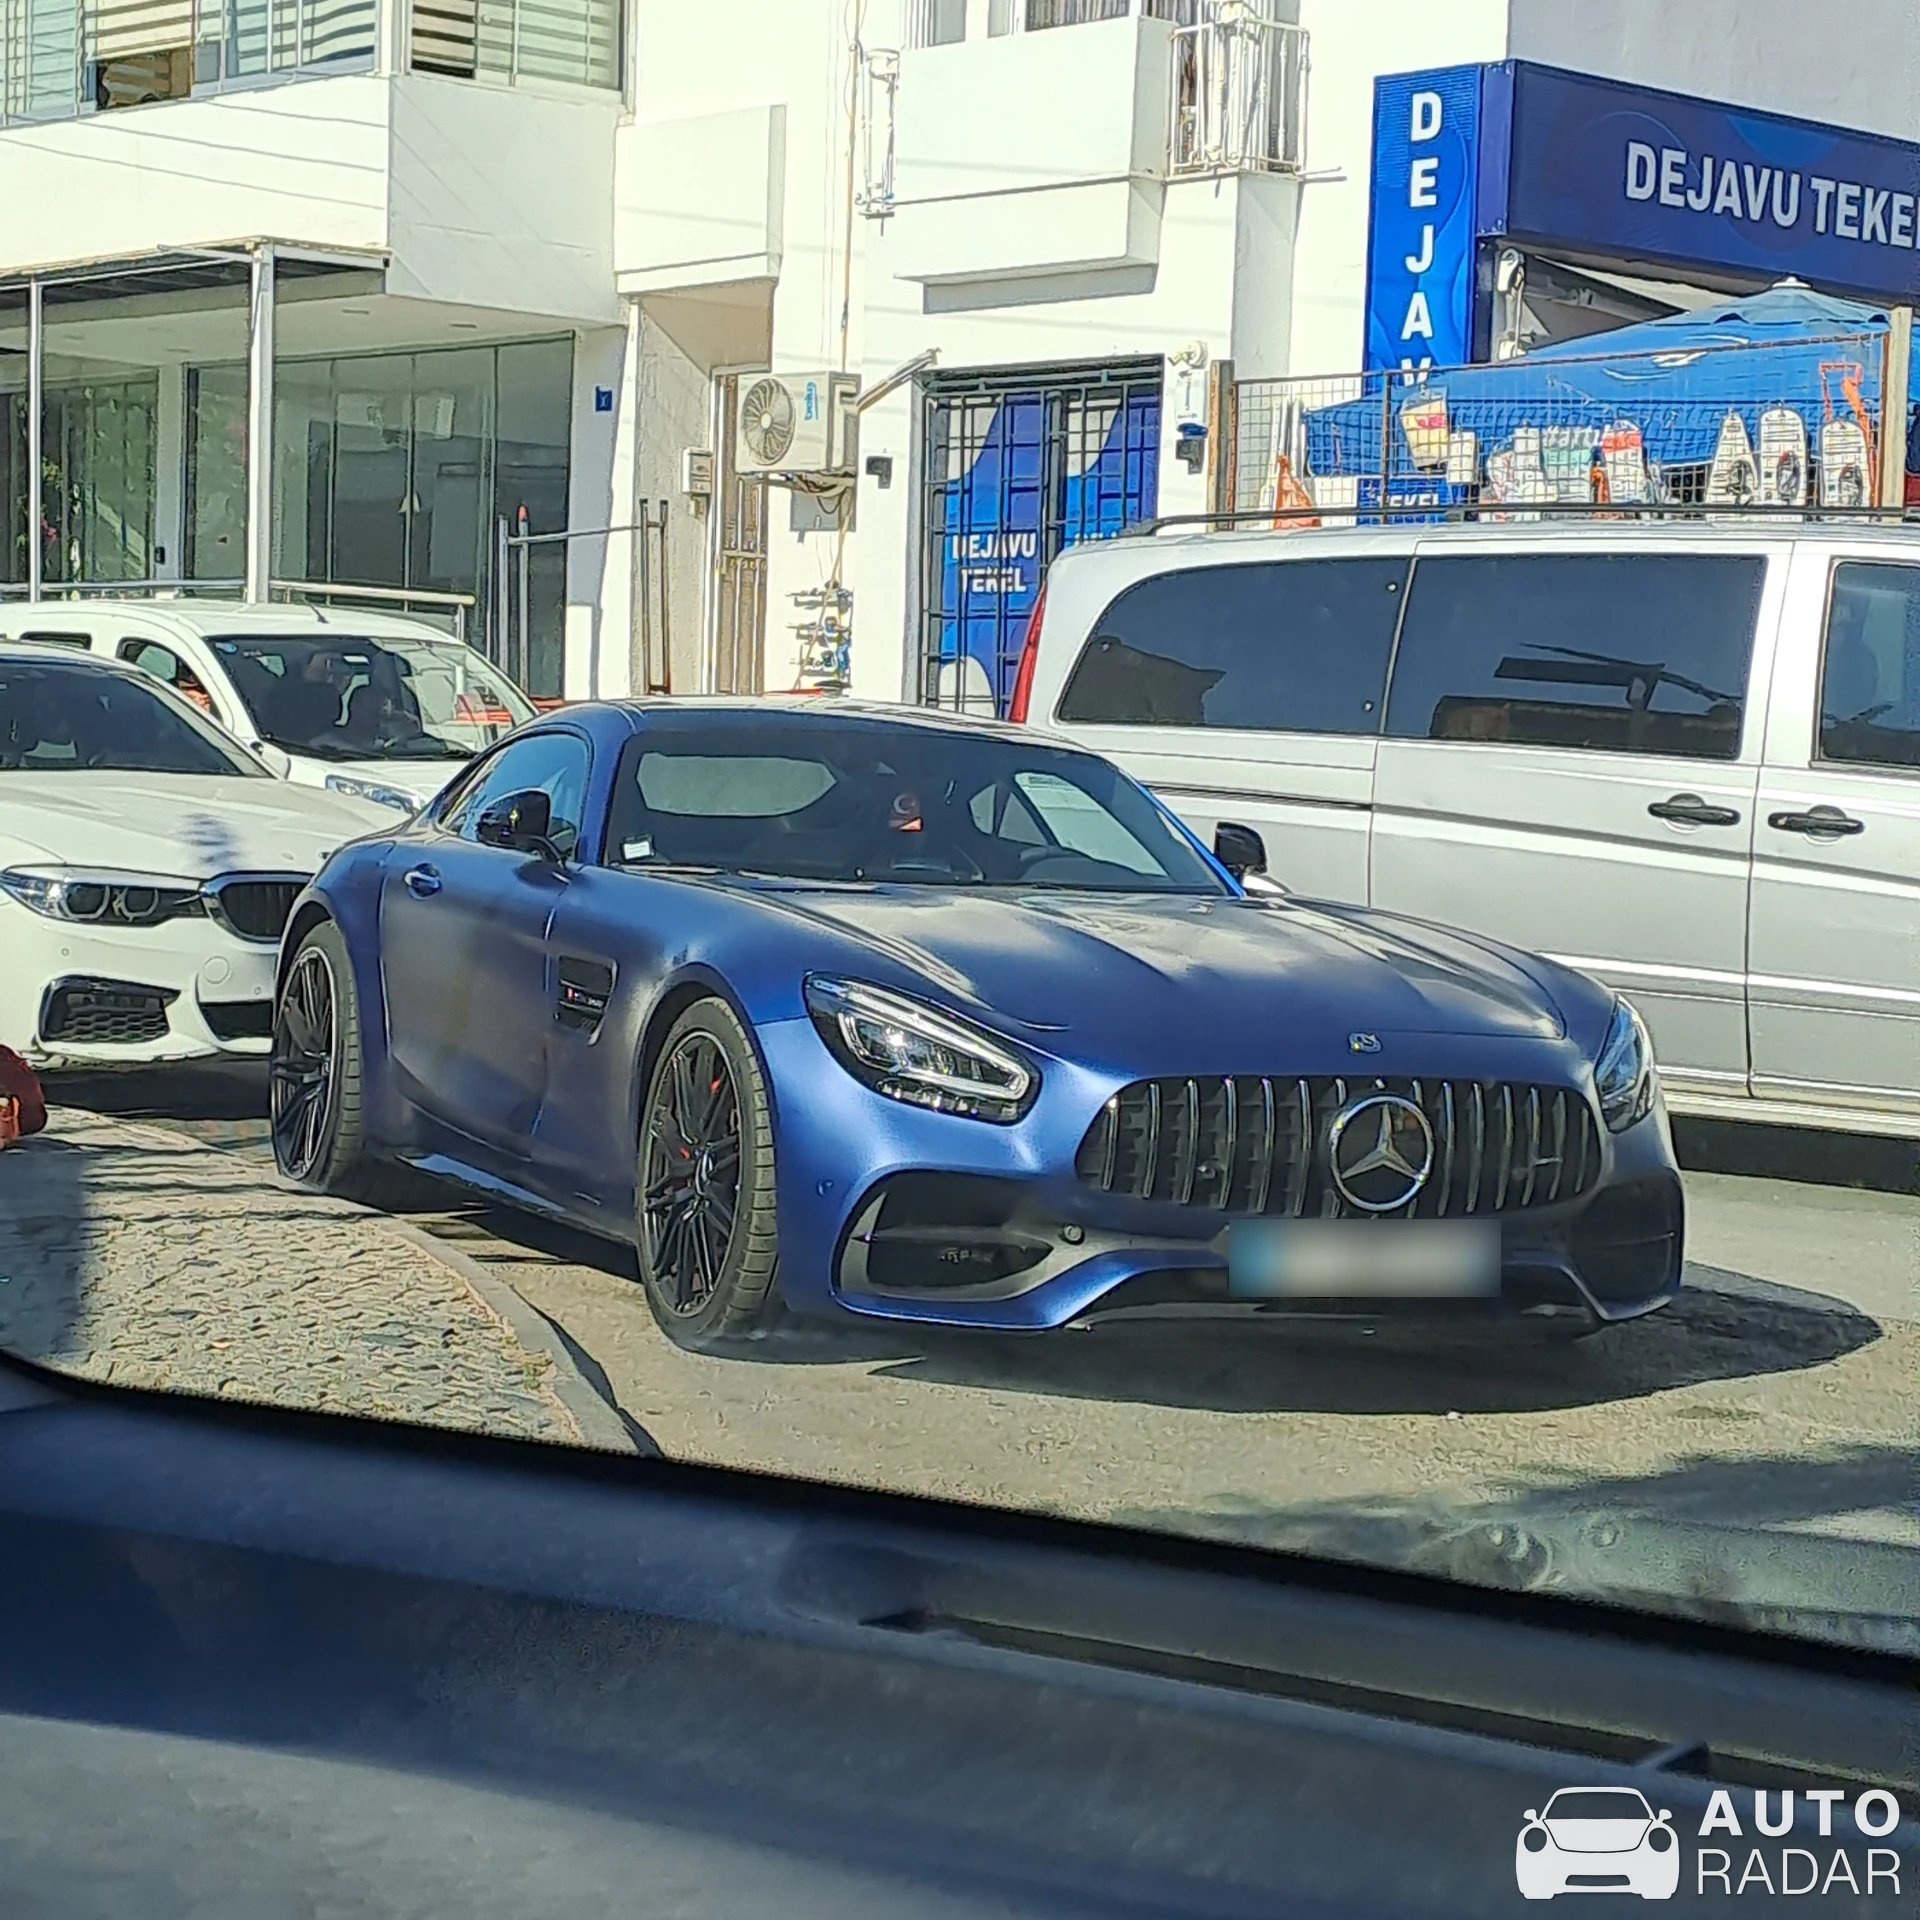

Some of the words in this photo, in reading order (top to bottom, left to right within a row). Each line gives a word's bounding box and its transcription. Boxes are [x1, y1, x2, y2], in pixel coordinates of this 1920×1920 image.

[1626, 140, 1801, 228] DEJAVU
[1810, 176, 1920, 250] TEKE
[1401, 91, 1442, 387] DEJAV
[952, 533, 1037, 559] DEJAVU
[961, 567, 1027, 593] TEKEL
